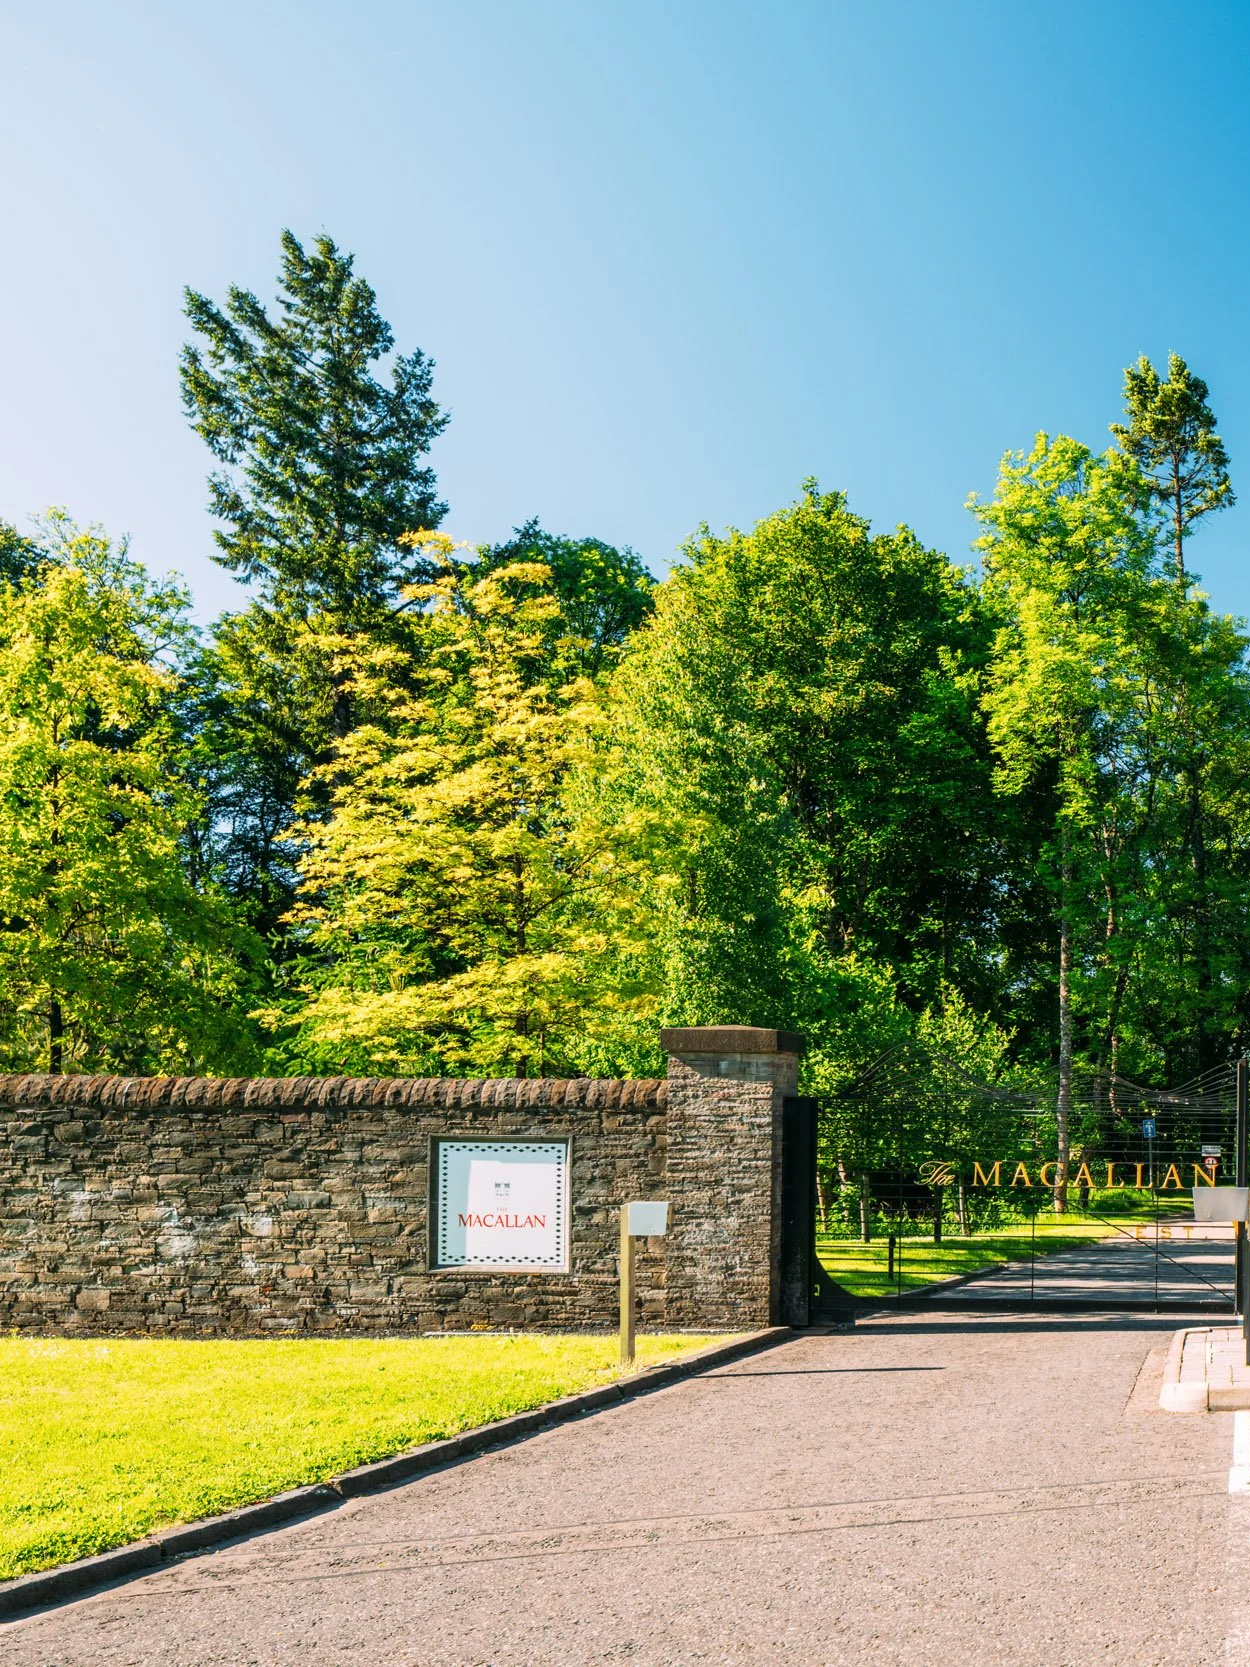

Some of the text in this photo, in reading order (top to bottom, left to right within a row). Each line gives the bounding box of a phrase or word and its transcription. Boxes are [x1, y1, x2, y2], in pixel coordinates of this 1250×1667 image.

[914, 1161, 955, 1186] The
[972, 1162, 1219, 1189] MACALLAN
[458, 1214, 546, 1228] MACALLAN
